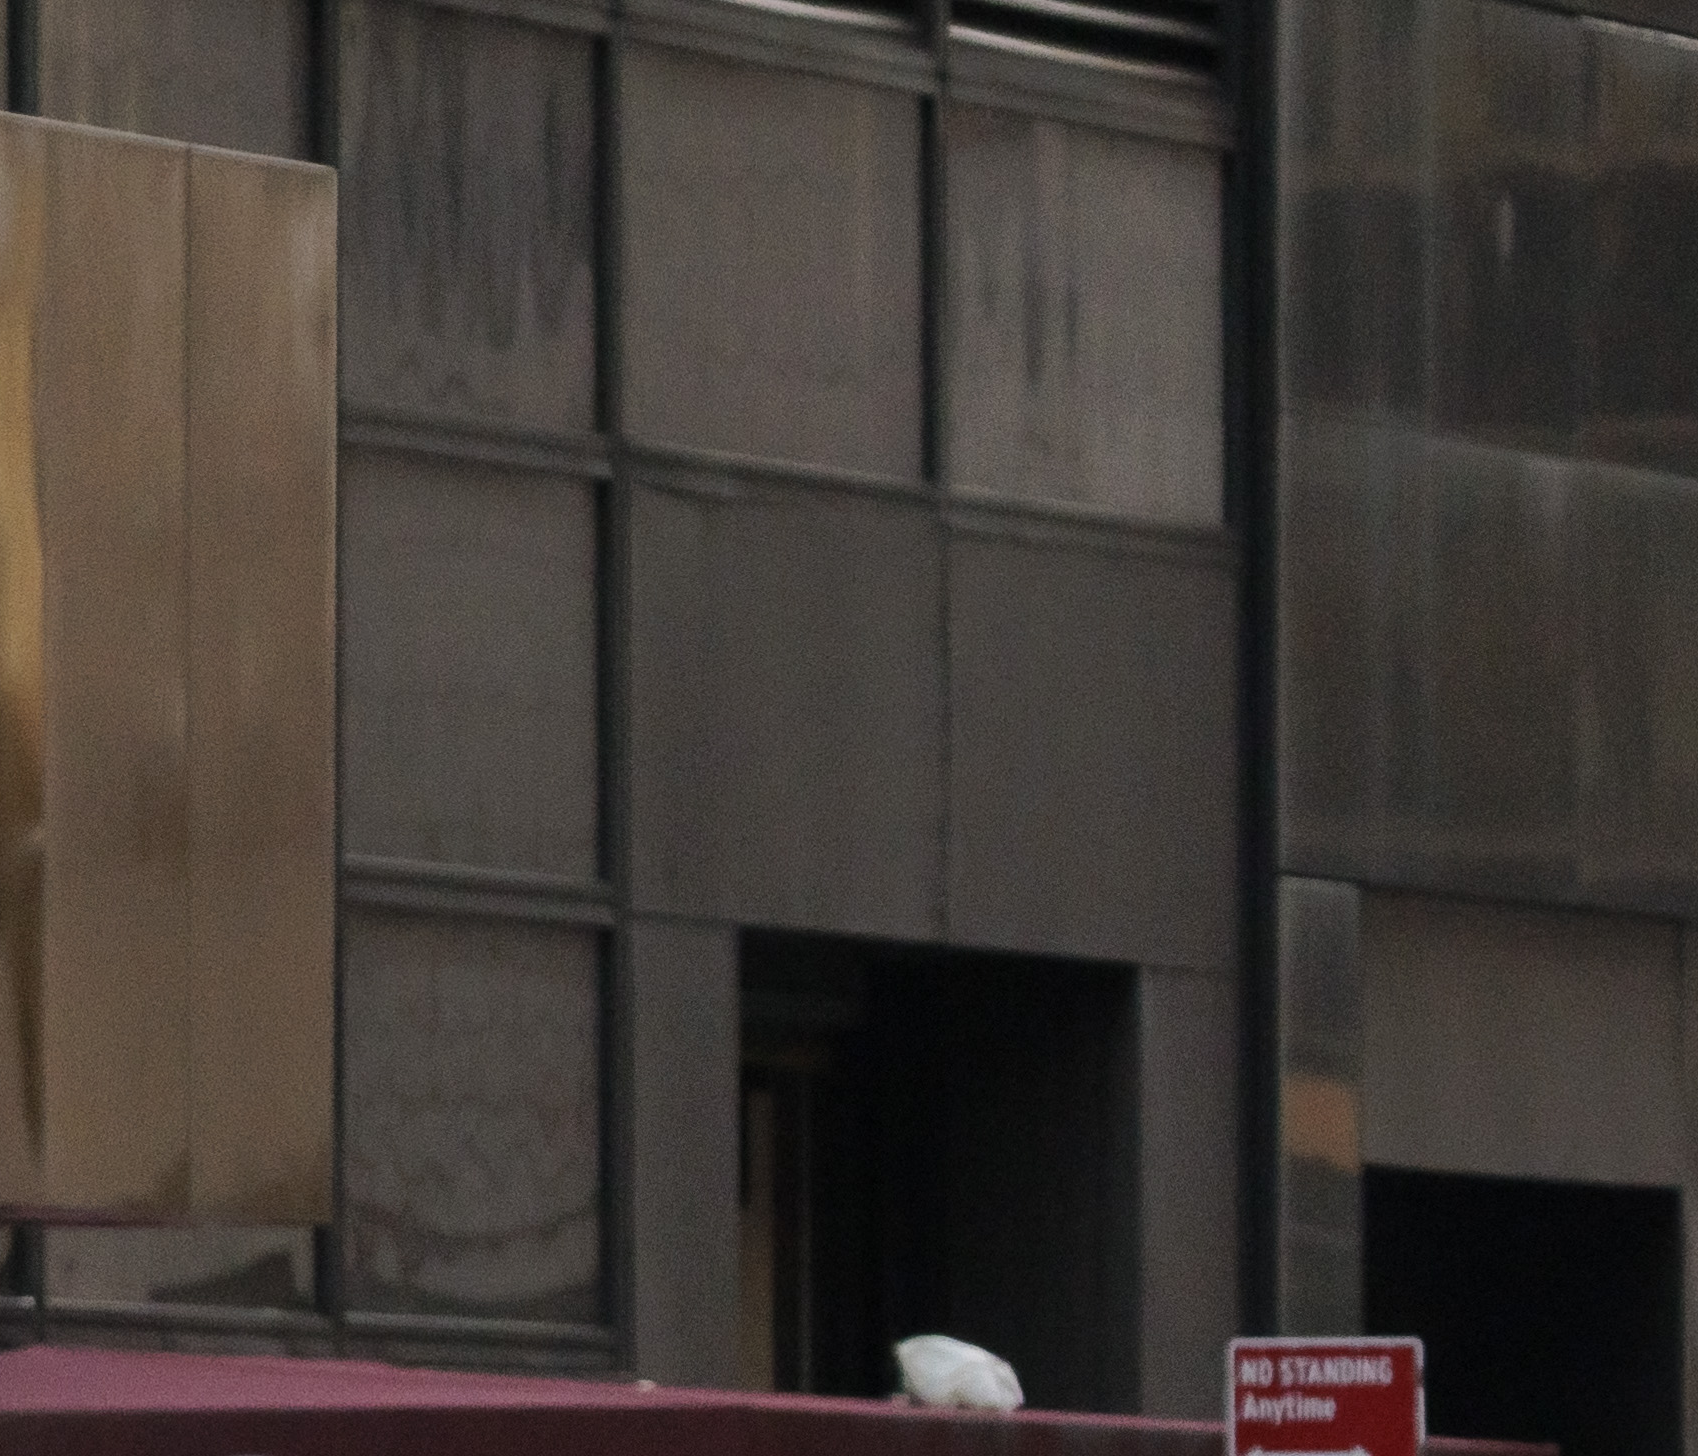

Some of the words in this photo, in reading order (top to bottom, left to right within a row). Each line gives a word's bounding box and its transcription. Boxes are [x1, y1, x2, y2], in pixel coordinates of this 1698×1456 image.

[1240, 1356, 1273, 1386] NO
[1279, 1356, 1393, 1388] STANDING
[1243, 1393, 1337, 1425] Anytime
